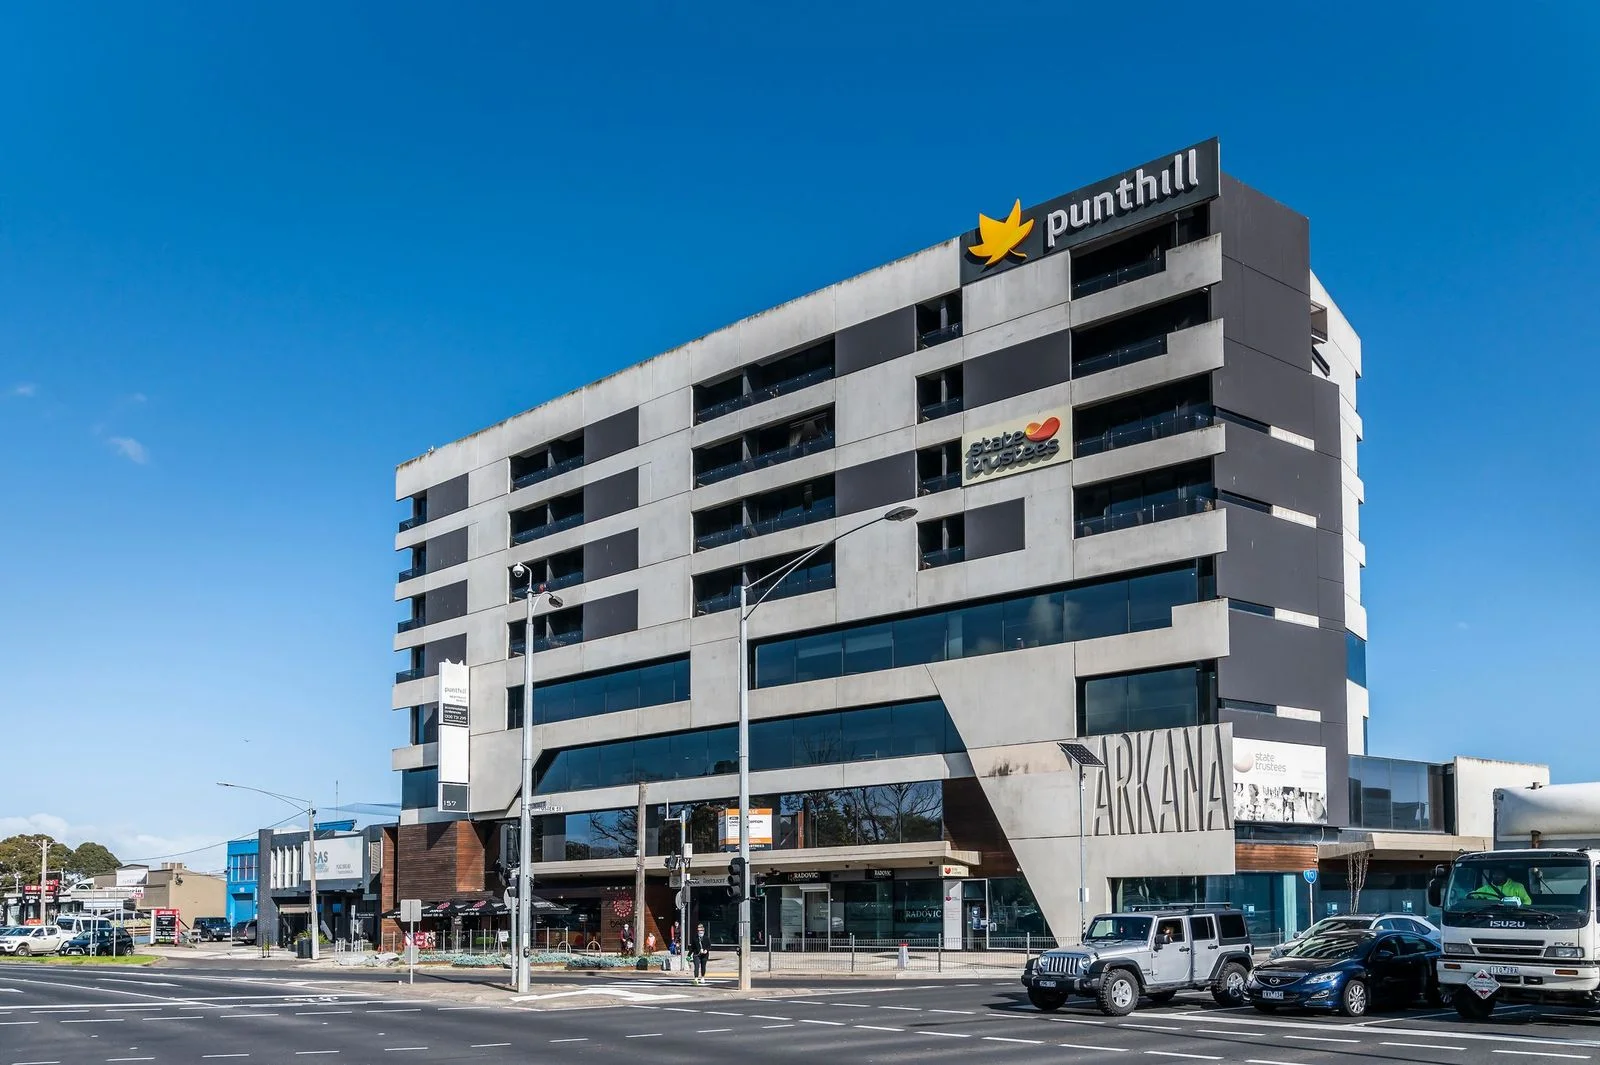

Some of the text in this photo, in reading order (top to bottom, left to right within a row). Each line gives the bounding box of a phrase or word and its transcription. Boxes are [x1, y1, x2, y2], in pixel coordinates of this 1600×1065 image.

[1047, 148, 1199, 248] punthill
[970, 430, 1025, 456] state
[967, 438, 1060, 475] trustees
[444, 687, 467, 695] punthill
[1255, 752, 1275, 762] state
[1255, 761, 1287, 773] trustees
[1092, 725, 1230, 836] ARKANA
[905, 909, 942, 918] RADOVIC
[1489, 920, 1526, 928] ISUZU
